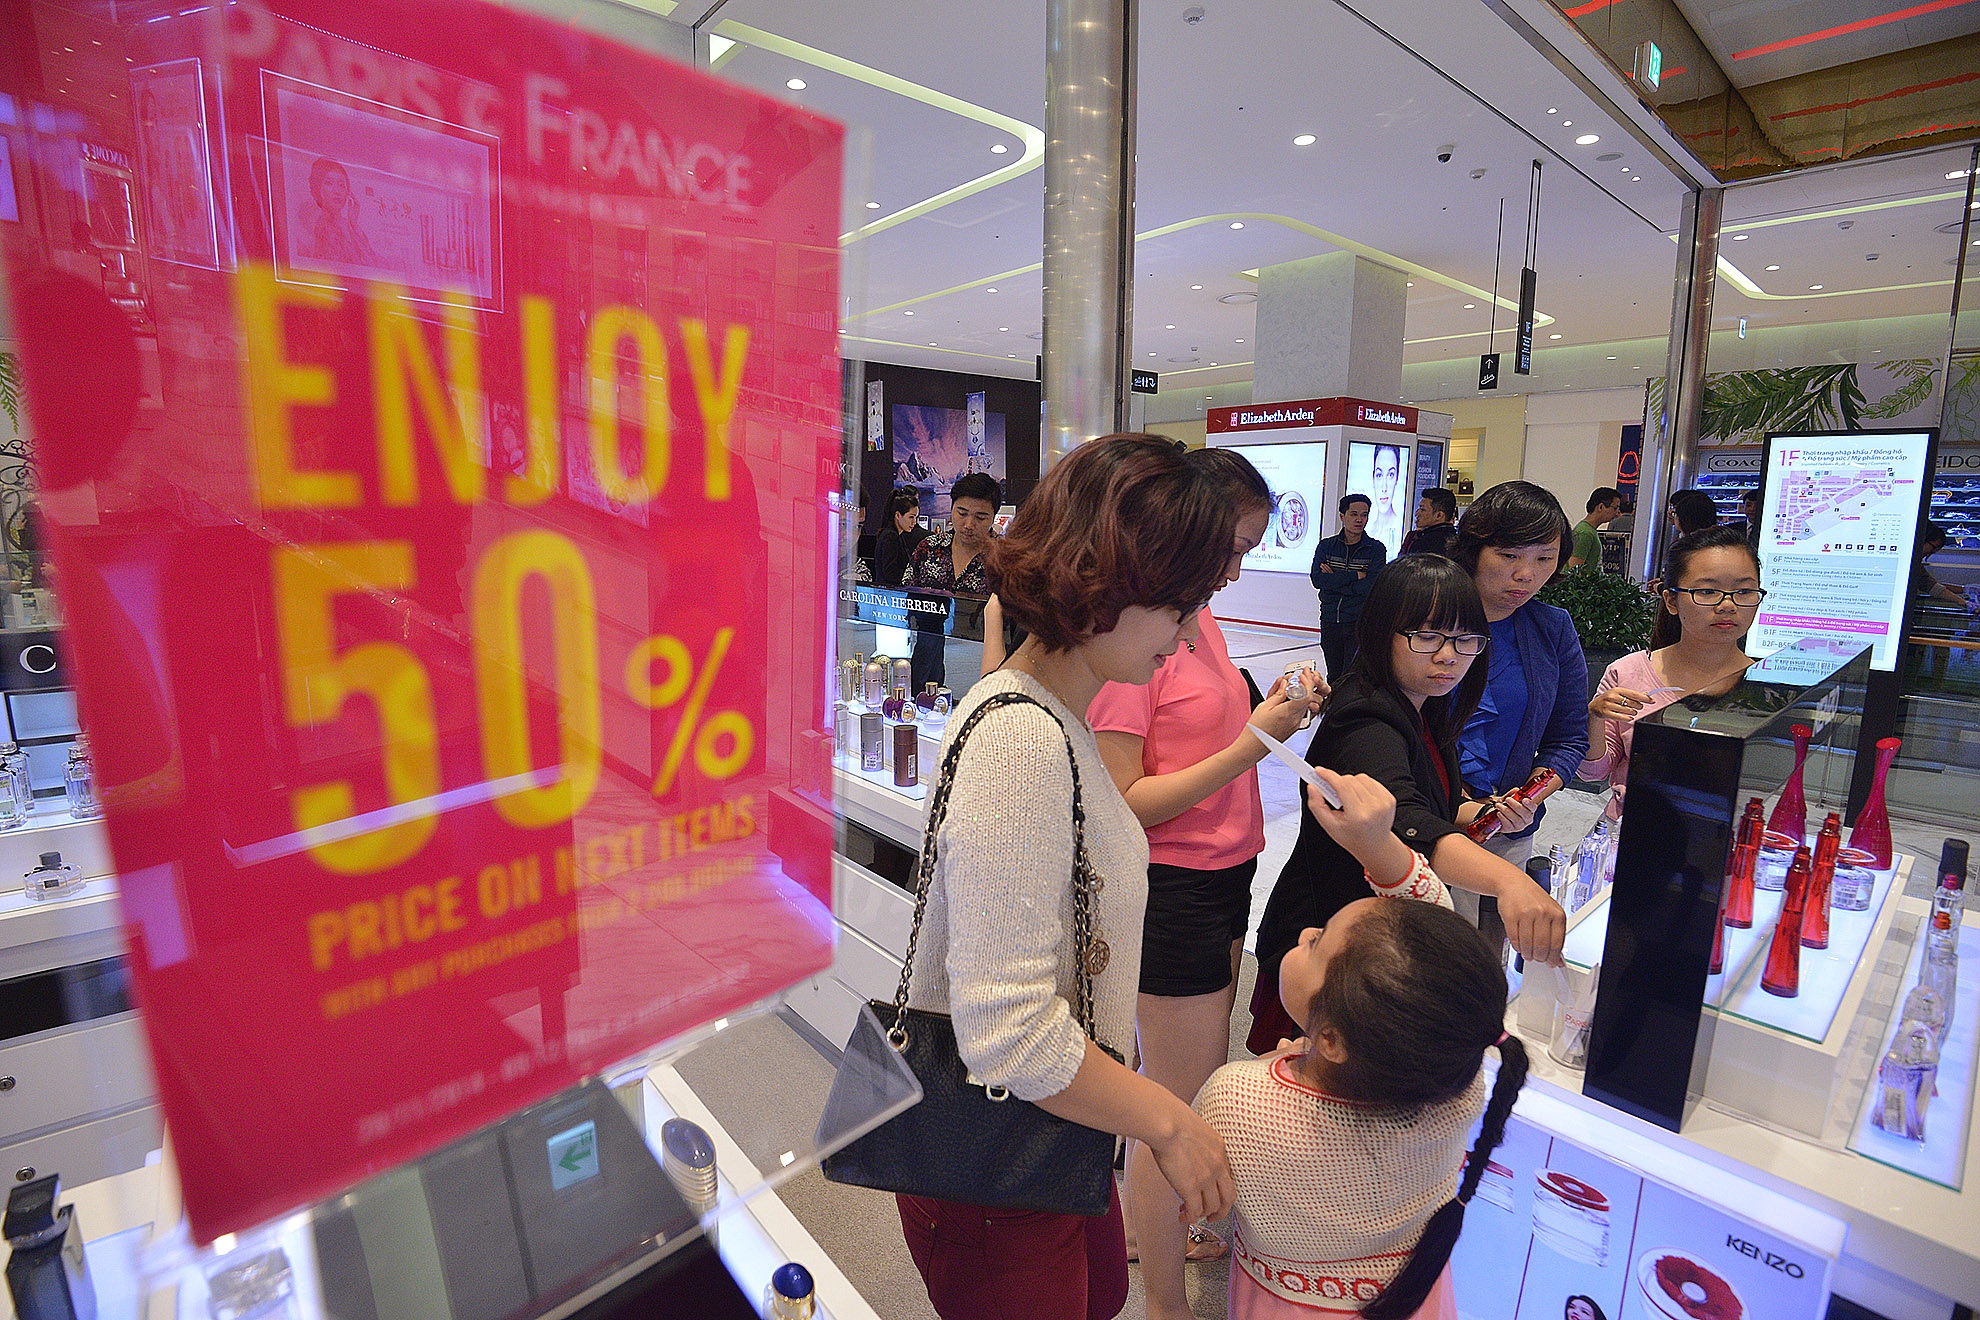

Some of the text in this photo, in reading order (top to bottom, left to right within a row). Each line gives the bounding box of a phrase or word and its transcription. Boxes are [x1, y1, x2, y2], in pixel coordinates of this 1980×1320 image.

[525, 72, 753, 213] FRANCE
[234, 262, 753, 512] ENJOY
[1714, 459, 1761, 467] COAC
[1779, 450, 1800, 466] 1F
[1936, 454, 1980, 469] EIDO
[840, 589, 948, 615] CAROLINA HERRERA
[1768, 592, 1778, 600] 3F
[872, 610, 907, 622] NEW YORK
[272, 527, 757, 876] 50%
[307, 874, 468, 972] PRICE
[475, 852, 543, 920] ON
[657, 796, 757, 858] ITEMS
[1726, 1234, 1805, 1279] KENZO
